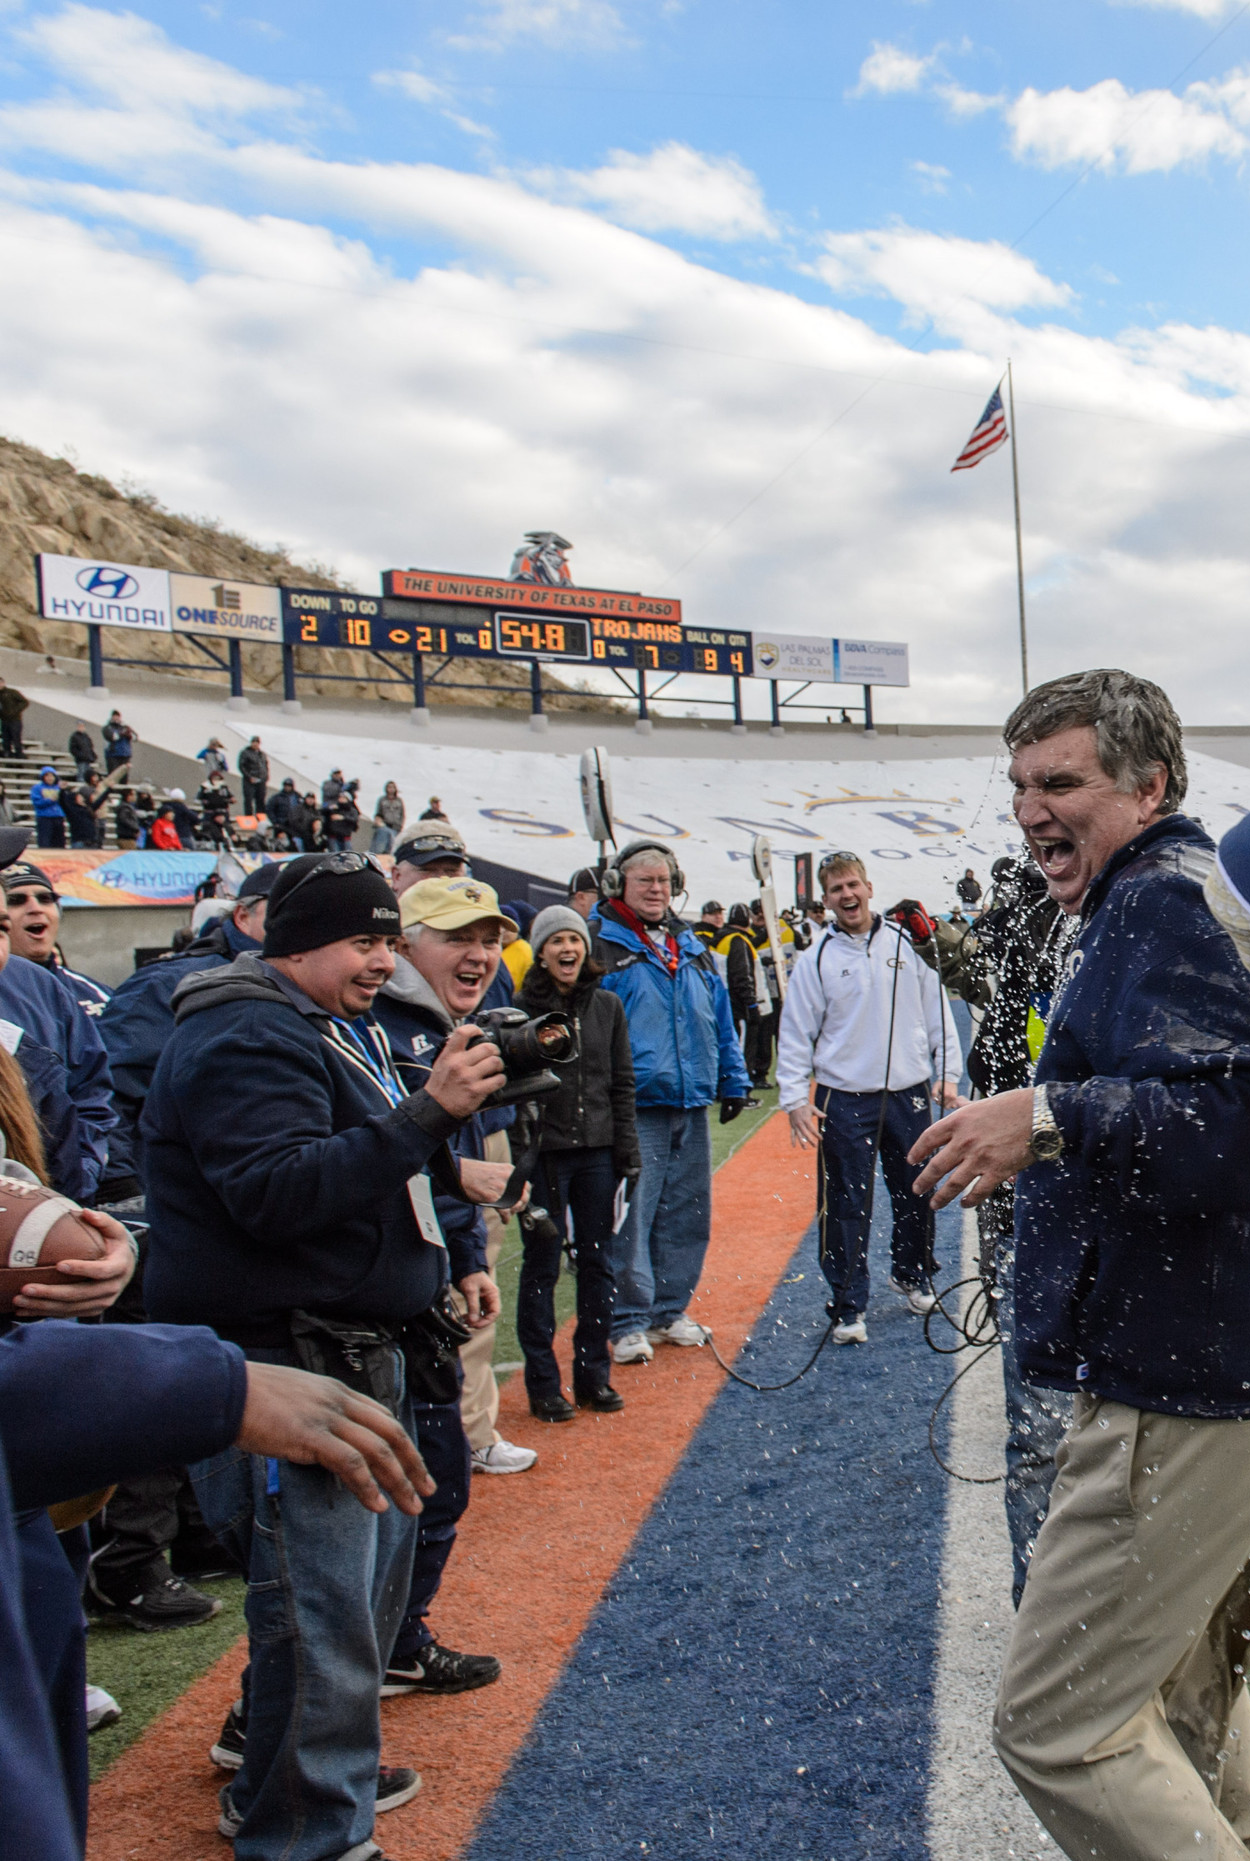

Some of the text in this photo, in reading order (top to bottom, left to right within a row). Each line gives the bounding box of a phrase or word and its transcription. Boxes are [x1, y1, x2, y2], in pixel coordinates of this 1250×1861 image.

[290, 593, 378, 616] DOWN TO GO
[404, 577, 673, 616] THE UNIVERSITY OF TEXAS AT EL PASO
[52, 597, 165, 627] HYUNDAI
[300, 615, 319, 642] 2
[346, 619, 371, 646] 10
[454, 632, 477, 645] TOL
[686, 630, 725, 646] BALL ON
[415, 626, 448, 653] 21
[593, 639, 606, 659] 0
[728, 634, 747, 647] QTR
[781, 643, 831, 655] LAS PALMAS
[608, 644, 628, 657] TOL
[644, 645, 660, 668] 7
[704, 648, 718, 671] 9
[729, 652, 744, 673] 4
[789, 656, 822, 667] DEL SOL
[372, 907, 400, 920] Nikon
